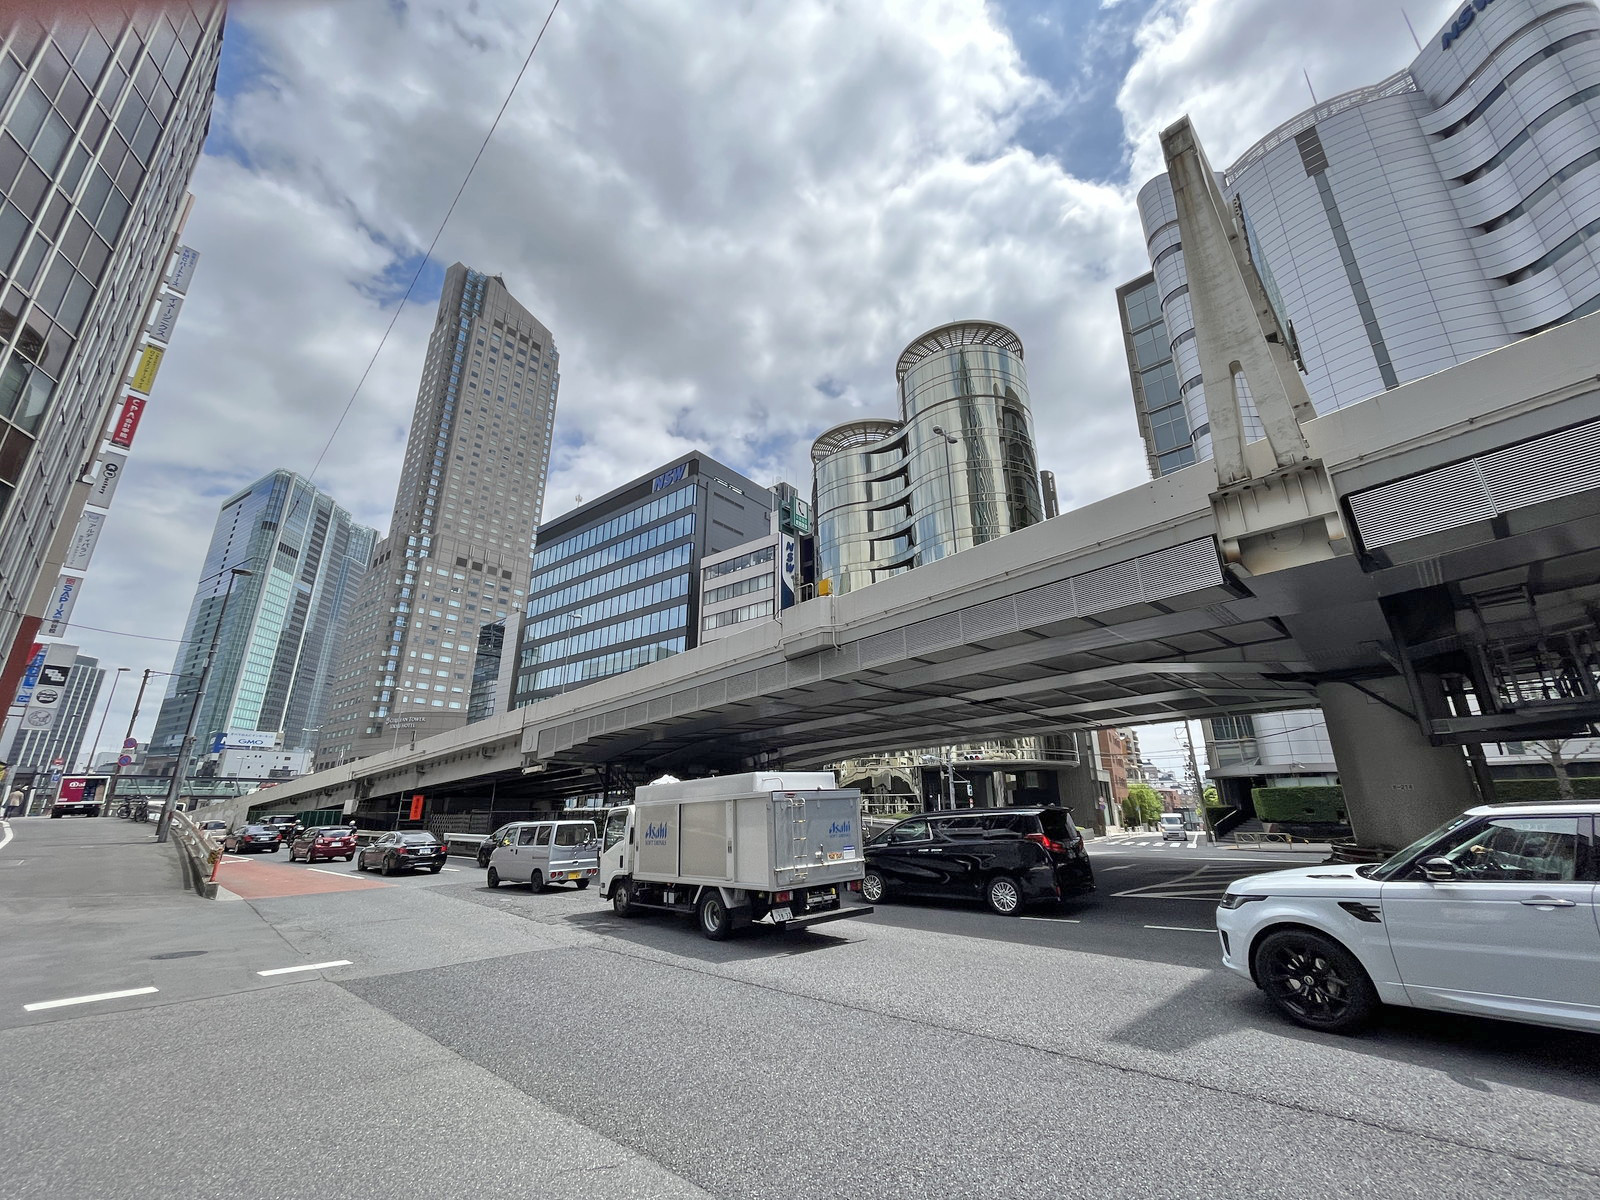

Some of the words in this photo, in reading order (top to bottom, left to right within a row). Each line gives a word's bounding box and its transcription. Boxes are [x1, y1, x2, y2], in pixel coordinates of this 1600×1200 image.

[654, 463, 686, 491] NSW
[786, 541, 795, 573] NSW
[54, 584, 74, 616] SAPIX
[645, 821, 667, 839] Asahi
[829, 820, 851, 834] Asahi
